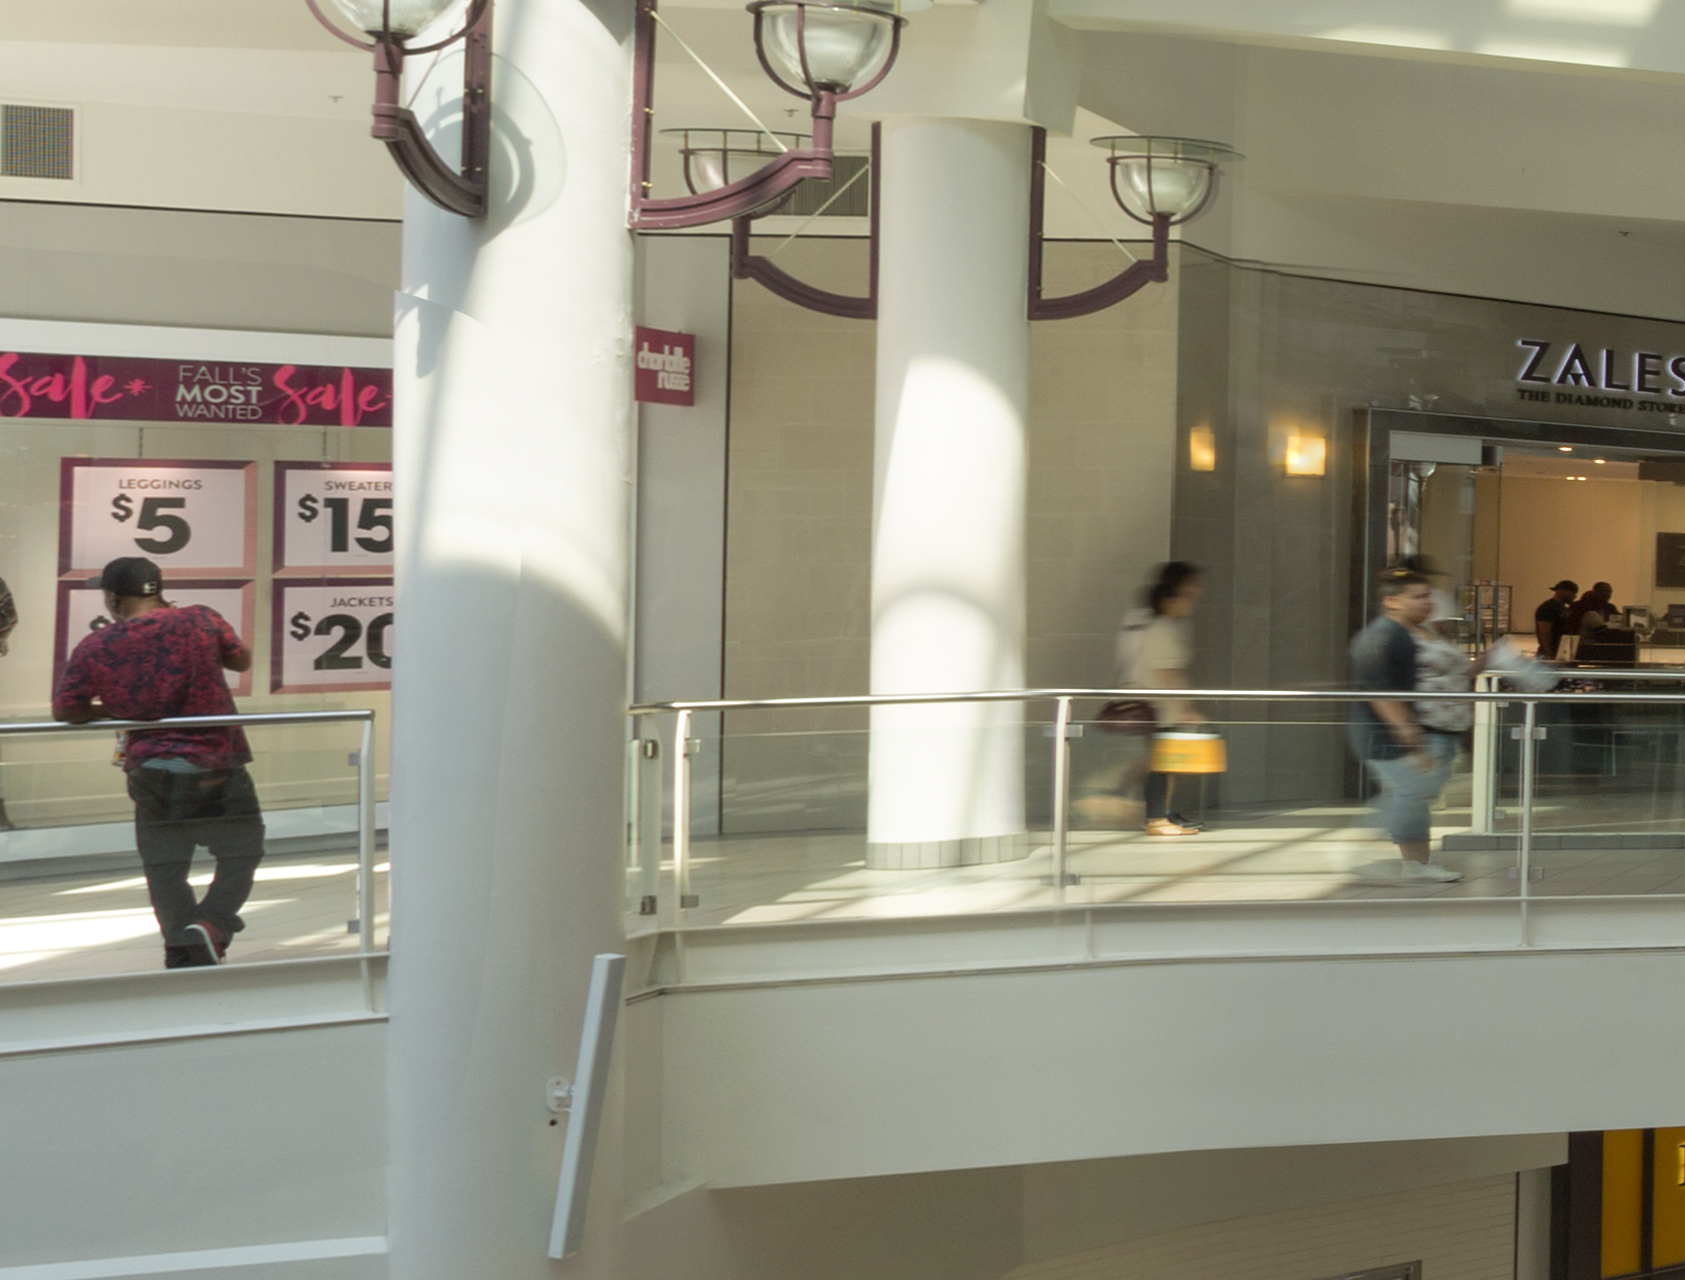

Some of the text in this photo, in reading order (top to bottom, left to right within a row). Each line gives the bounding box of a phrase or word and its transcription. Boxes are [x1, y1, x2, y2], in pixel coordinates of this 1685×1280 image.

[179, 365, 262, 385] FALL'S
[175, 384, 262, 404] MOST
[1517, 388, 1550, 402] THE
[1556, 392, 1634, 410] DIAMOND
[175, 404, 262, 420] WANTED
[118, 478, 203, 491] LEGGINGS
[324, 480, 393, 492] SWEATER
[111, 493, 191, 554] $5
[297, 493, 393, 553] $15
[330, 596, 393, 608] JACKETS
